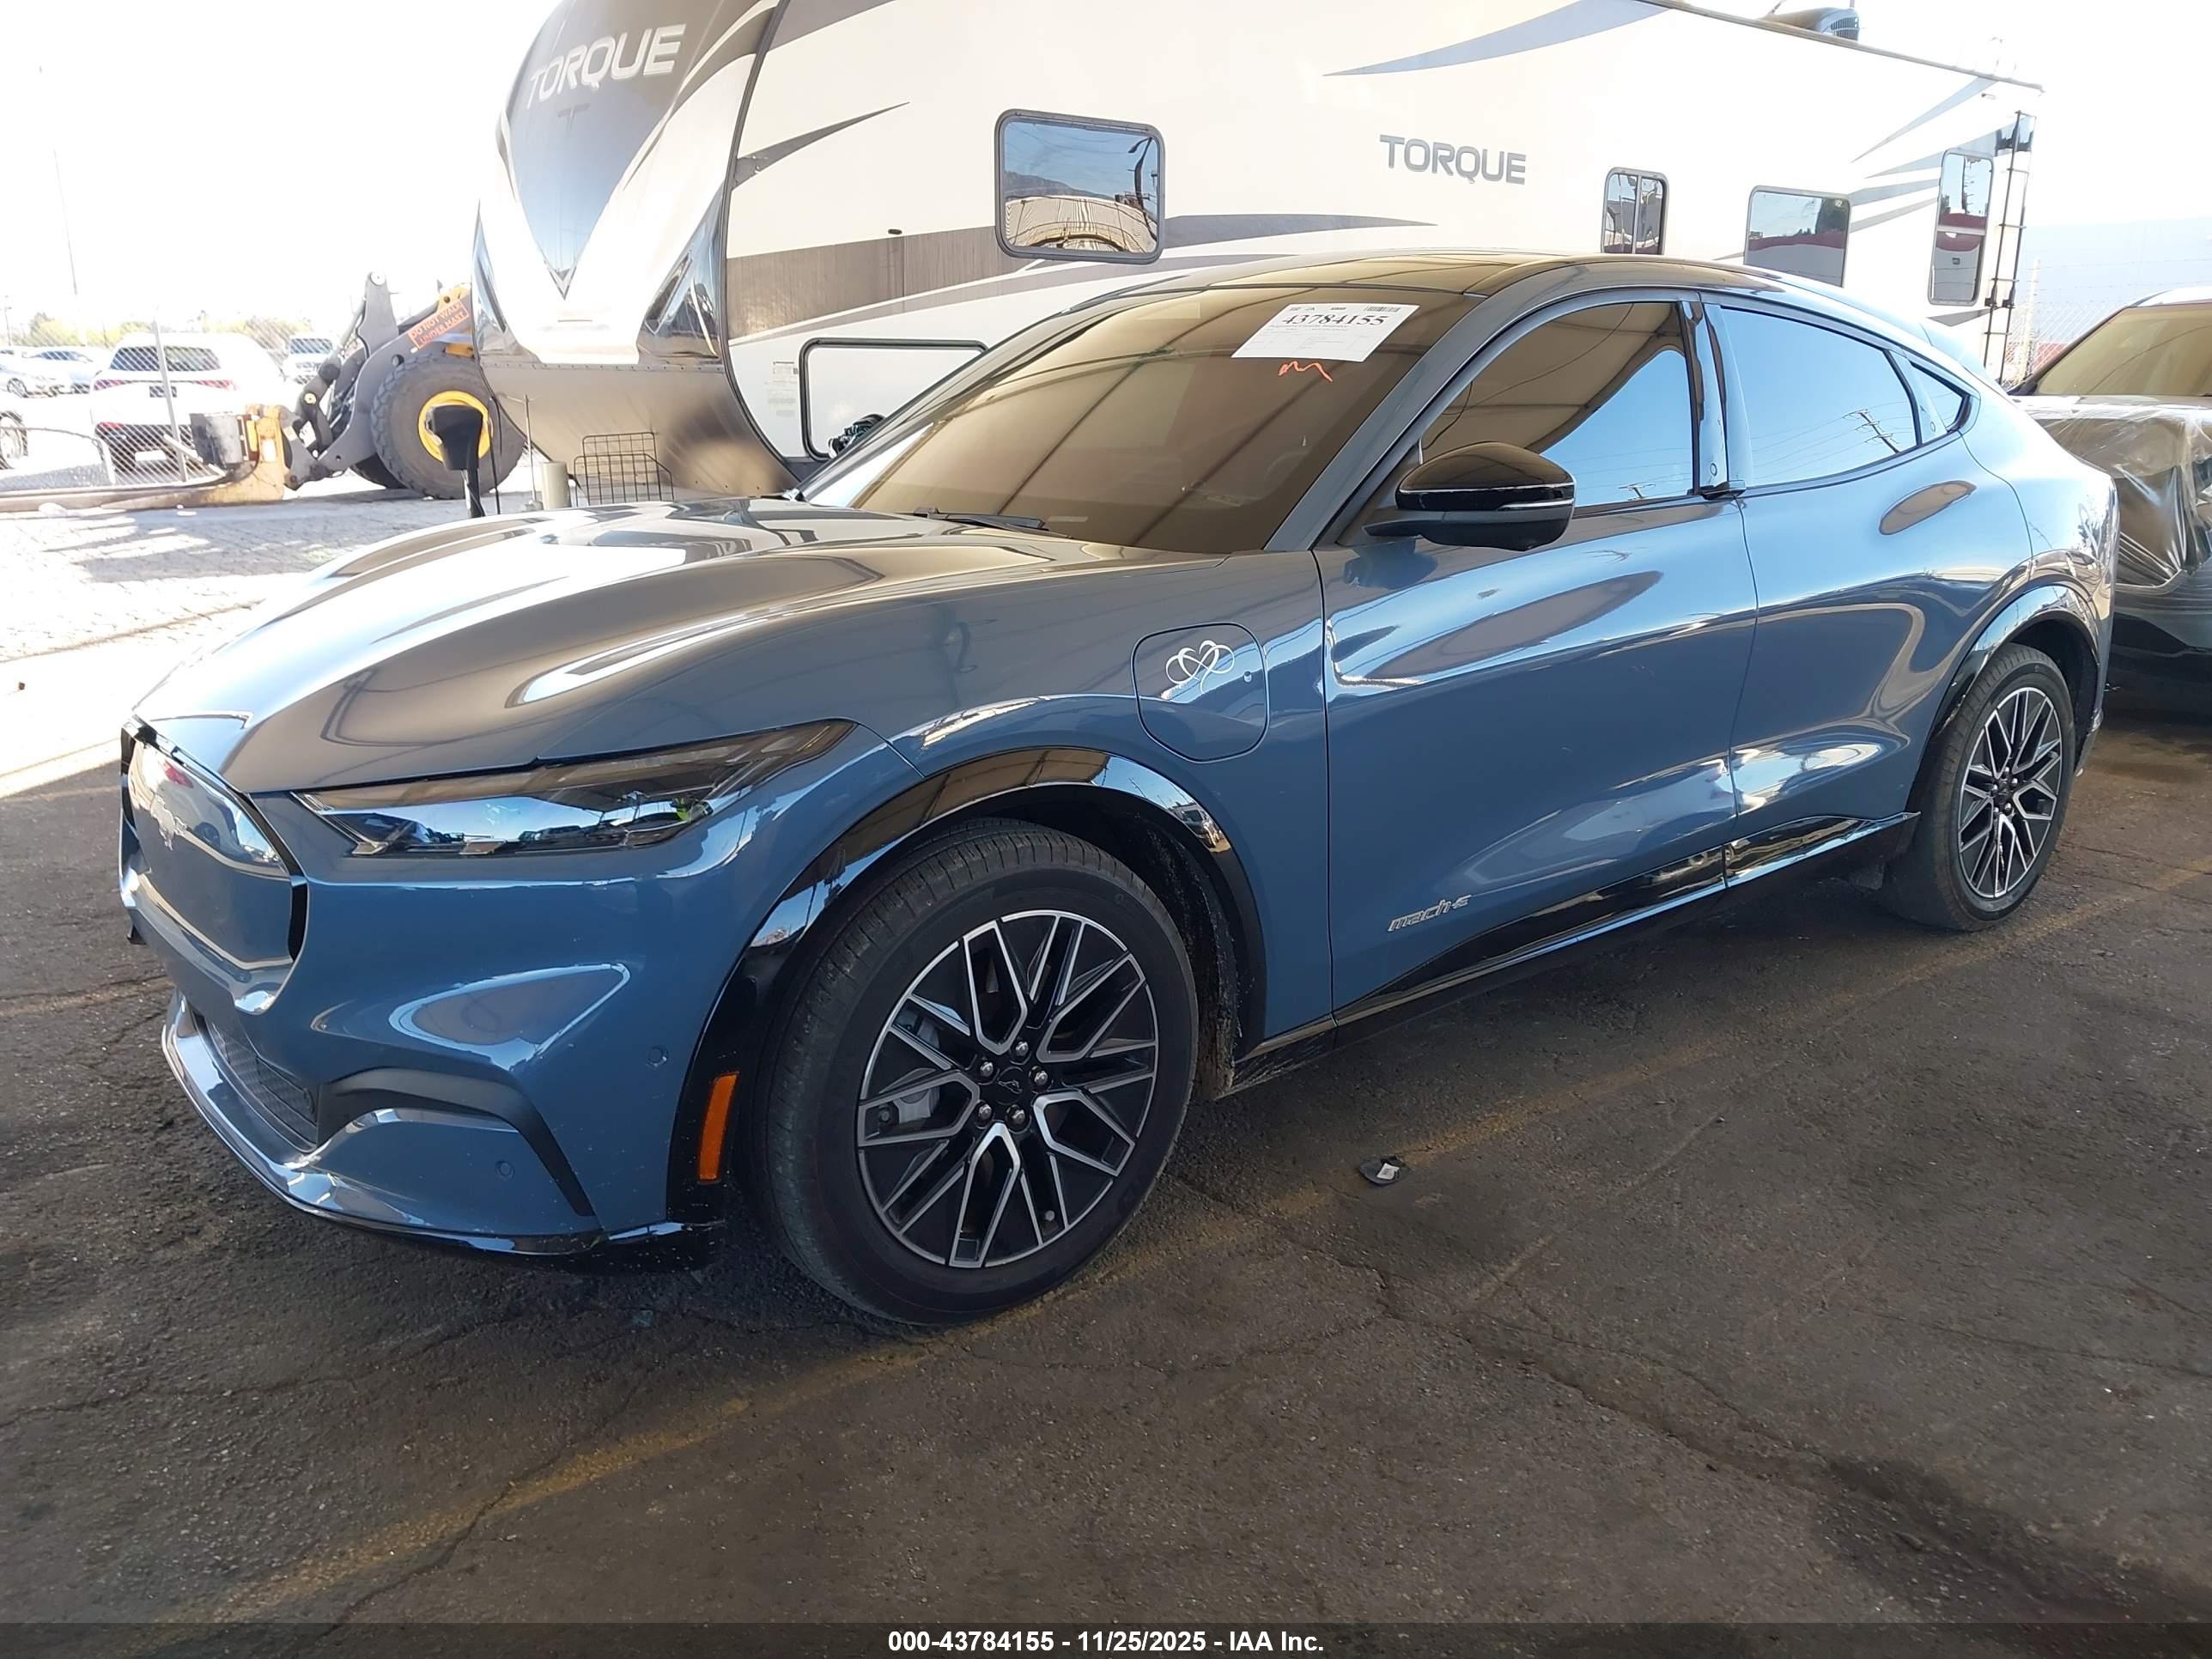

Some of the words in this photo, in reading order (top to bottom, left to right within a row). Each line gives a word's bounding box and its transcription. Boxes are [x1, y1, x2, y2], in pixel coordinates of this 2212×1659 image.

[526, 23, 687, 110] TORQUE
[1380, 134, 1526, 185] TORQUE
[422, 315, 440, 331] NOT
[1282, 313, 1389, 326] 43784155
